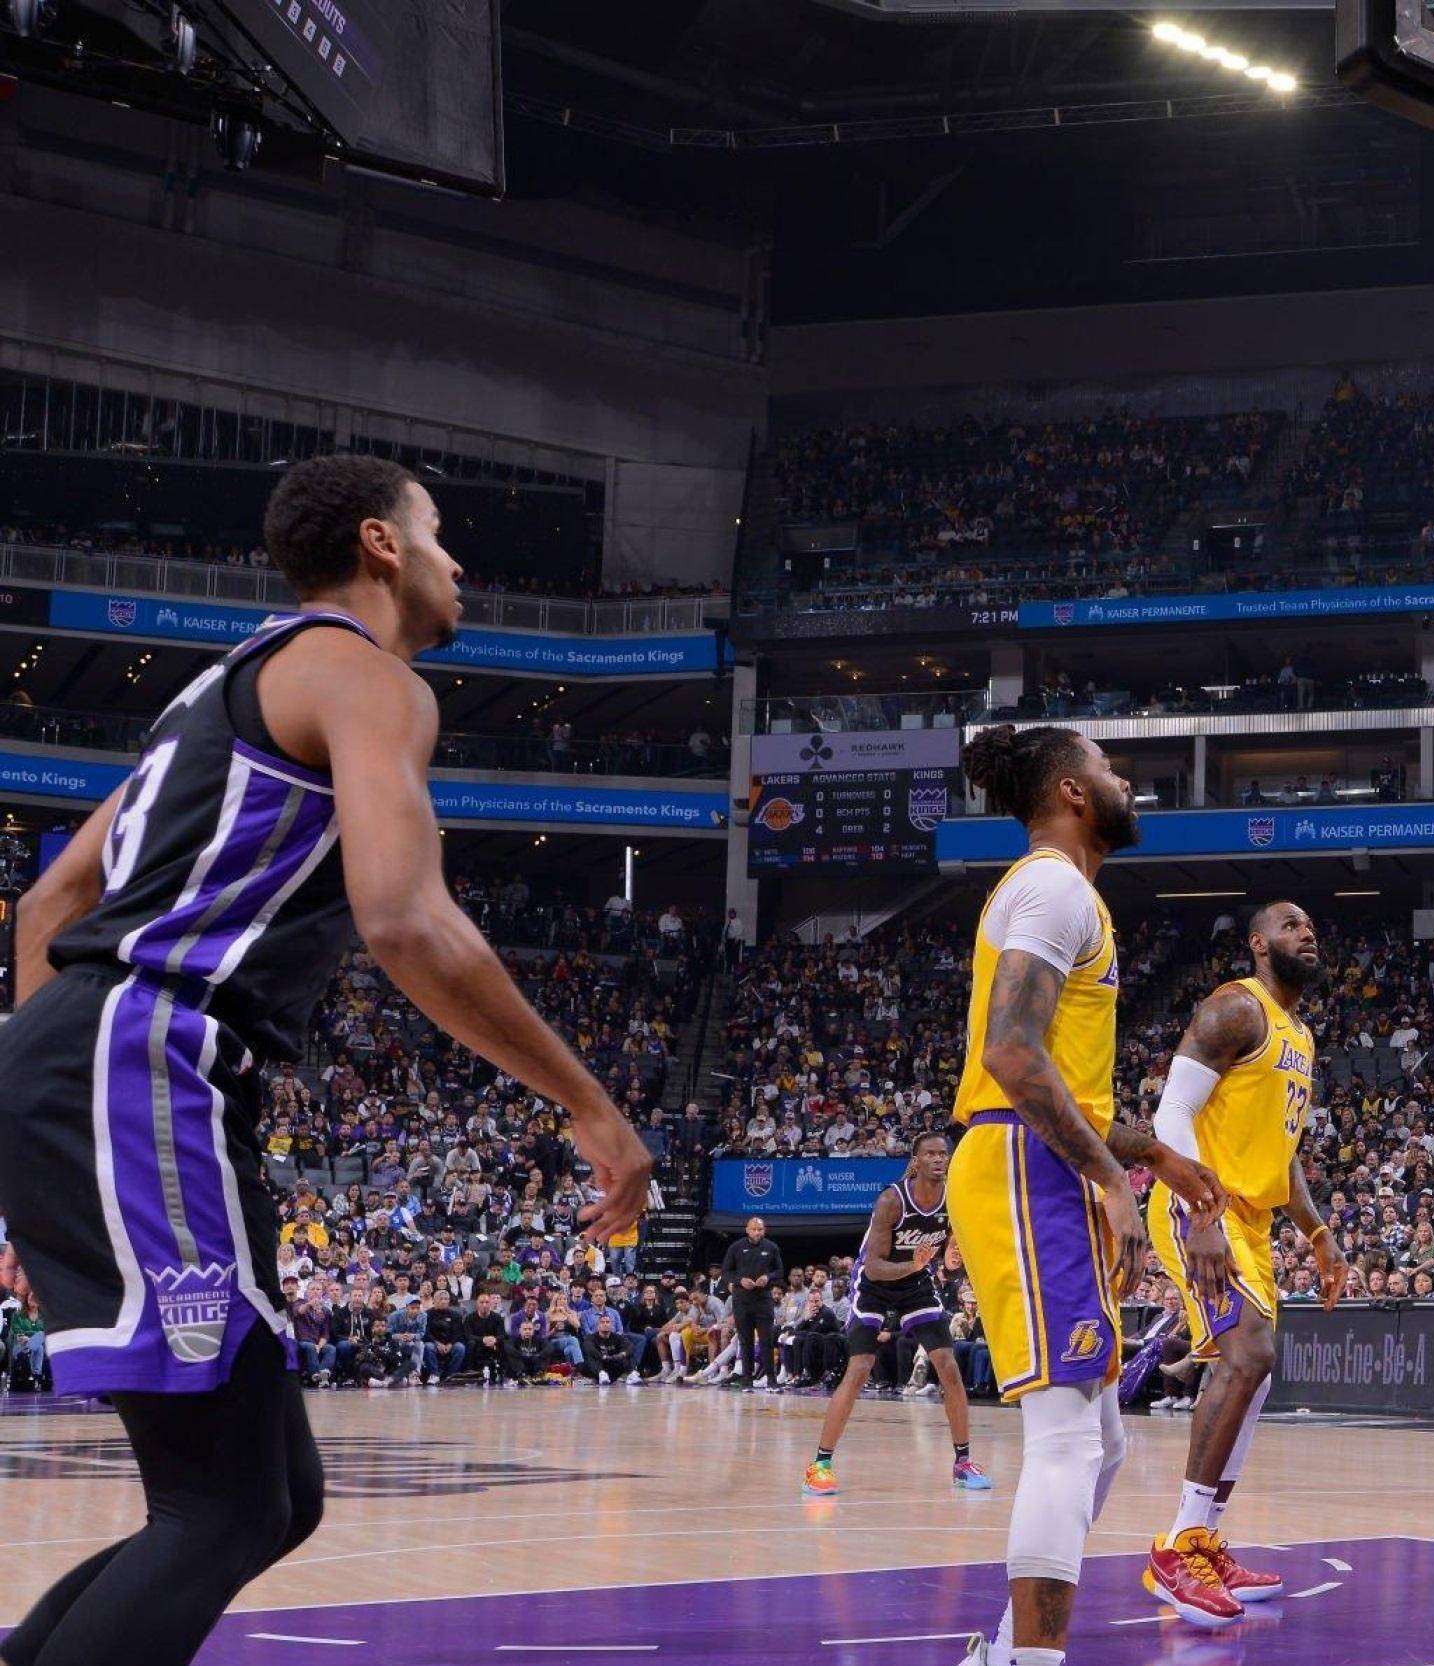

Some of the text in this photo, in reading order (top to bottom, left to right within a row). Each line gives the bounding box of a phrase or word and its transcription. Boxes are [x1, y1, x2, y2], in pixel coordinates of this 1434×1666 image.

[1106, 607, 1139, 619] KAISER
[1141, 605, 1207, 618] PERMANENTE
[1236, 602, 1277, 614] Trusted
[1279, 600, 1308, 613] Team
[1311, 598, 1367, 612] Physicians
[1370, 596, 1382, 609] of
[1383, 595, 1401, 608] the
[183, 616, 226, 632] KAISER
[971, 610, 1019, 625] 7:21 PM
[452, 641, 684, 665] Physicians of the Sacramento Kings
[41, 771, 86, 788] Kings
[761, 774, 800, 785] LAKERS
[913, 770, 945, 780] KINGS
[884, 789, 891, 800] 0
[461, 796, 530, 812] Physicians
[534, 797, 549, 811] of
[551, 799, 572, 813] the
[575, 801, 657, 816] Sacramento
[660, 804, 700, 820] Kings
[883, 806, 891, 816] 0
[882, 823, 890, 833] 2
[1320, 823, 1364, 839] KAISER
[1274, 1039, 1313, 1078] LAKE
[828, 1172, 855, 1182] KAISER
[827, 1182, 882, 1192] PERMANENTE
[895, 1229, 947, 1250] Kings
[1282, 1331, 1342, 1384] Noches
